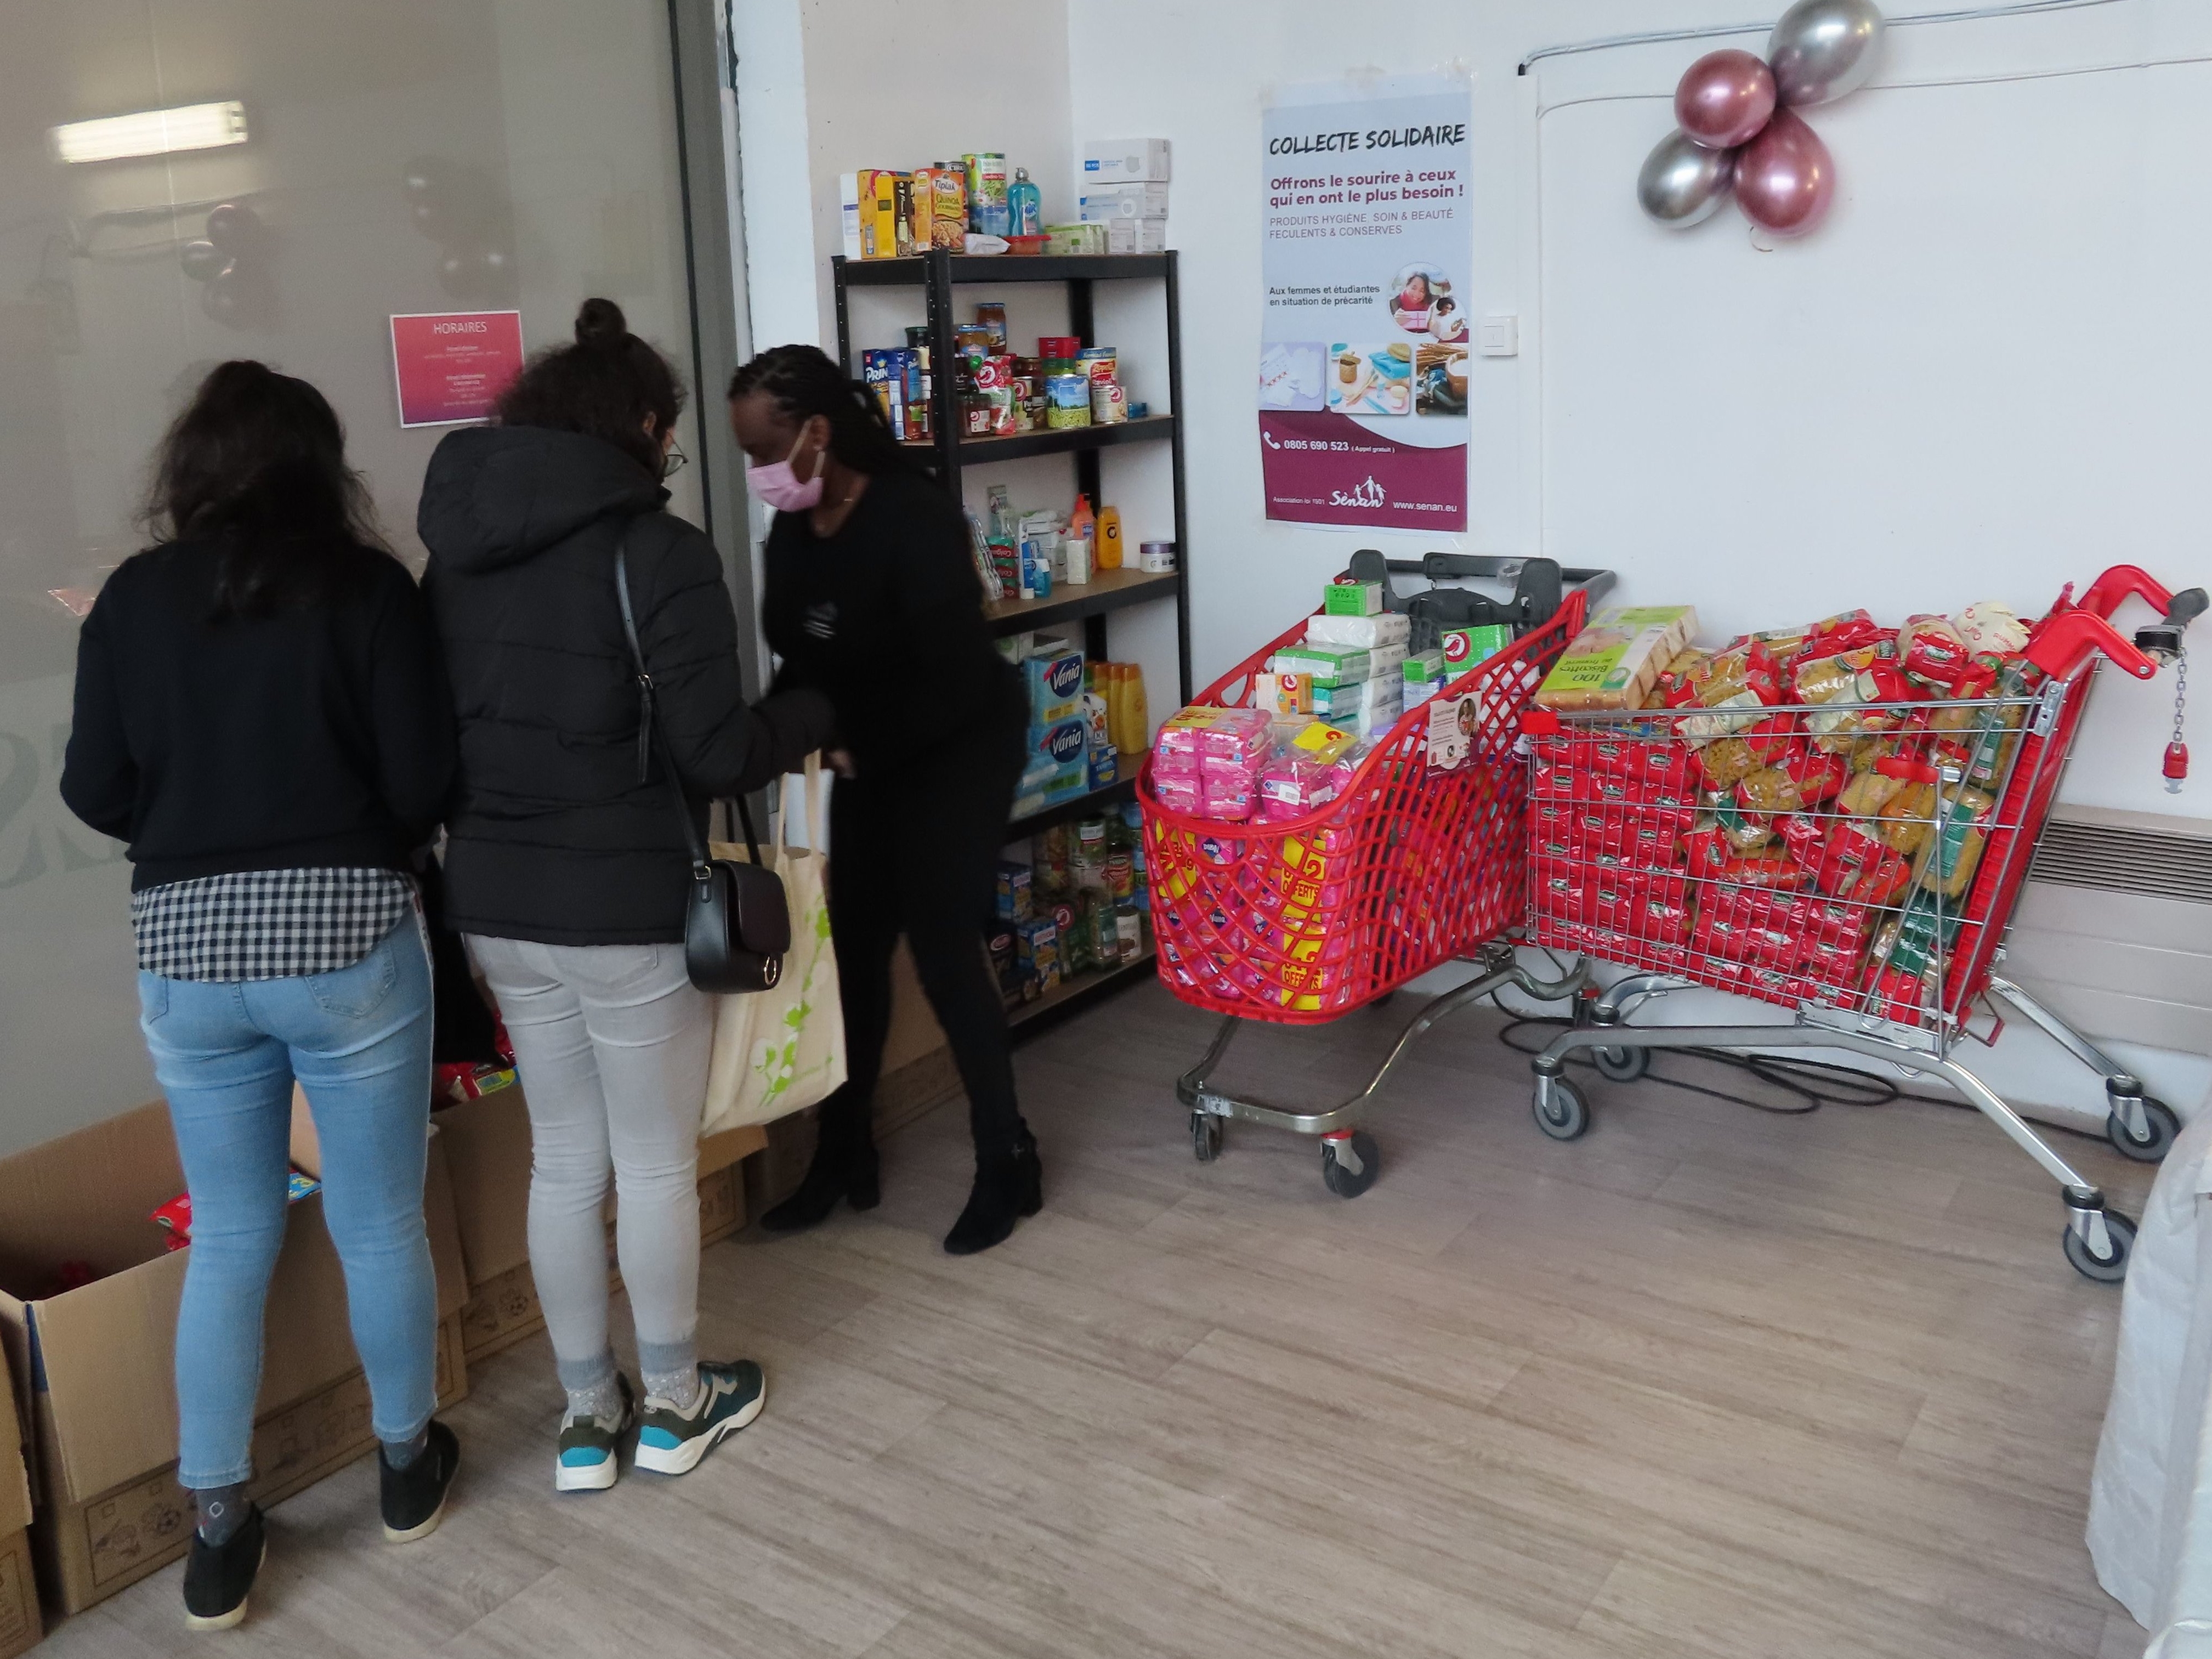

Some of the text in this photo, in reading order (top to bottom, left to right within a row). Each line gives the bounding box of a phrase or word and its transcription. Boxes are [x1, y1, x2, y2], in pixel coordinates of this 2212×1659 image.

[1270, 124, 1465, 155] COLLECTE SOLIDAIRE
[1271, 169, 1456, 190] Offrons le sourire à ceux
[1270, 184, 1464, 209] qui en ont le plus besoin !
[1269, 216, 1319, 227] PRODUITS
[1373, 212, 1398, 222] SOIN
[1401, 212, 1408, 220] &
[1411, 207, 1454, 220] BEAUTÉ
[1269, 225, 1403, 239] FECULENTS & CONSERVES
[1288, 286, 1321, 295] femmes
[1334, 285, 1380, 294] étudiantes
[1282, 297, 1319, 305] situation
[1321, 297, 1331, 305] de
[1334, 296, 1373, 307] précarité
[433, 321, 488, 335] HORAIRES
[1284, 440, 1308, 450] 0805
[1310, 440, 1328, 450] 690
[1330, 441, 1349, 451] 523
[1273, 496, 1303, 504] Association
[1393, 501, 1457, 513] www.senan.eu
[1053, 663, 1081, 690] Vania
[1572, 673, 1601, 682] 100
[1052, 728, 1082, 756] Vania
